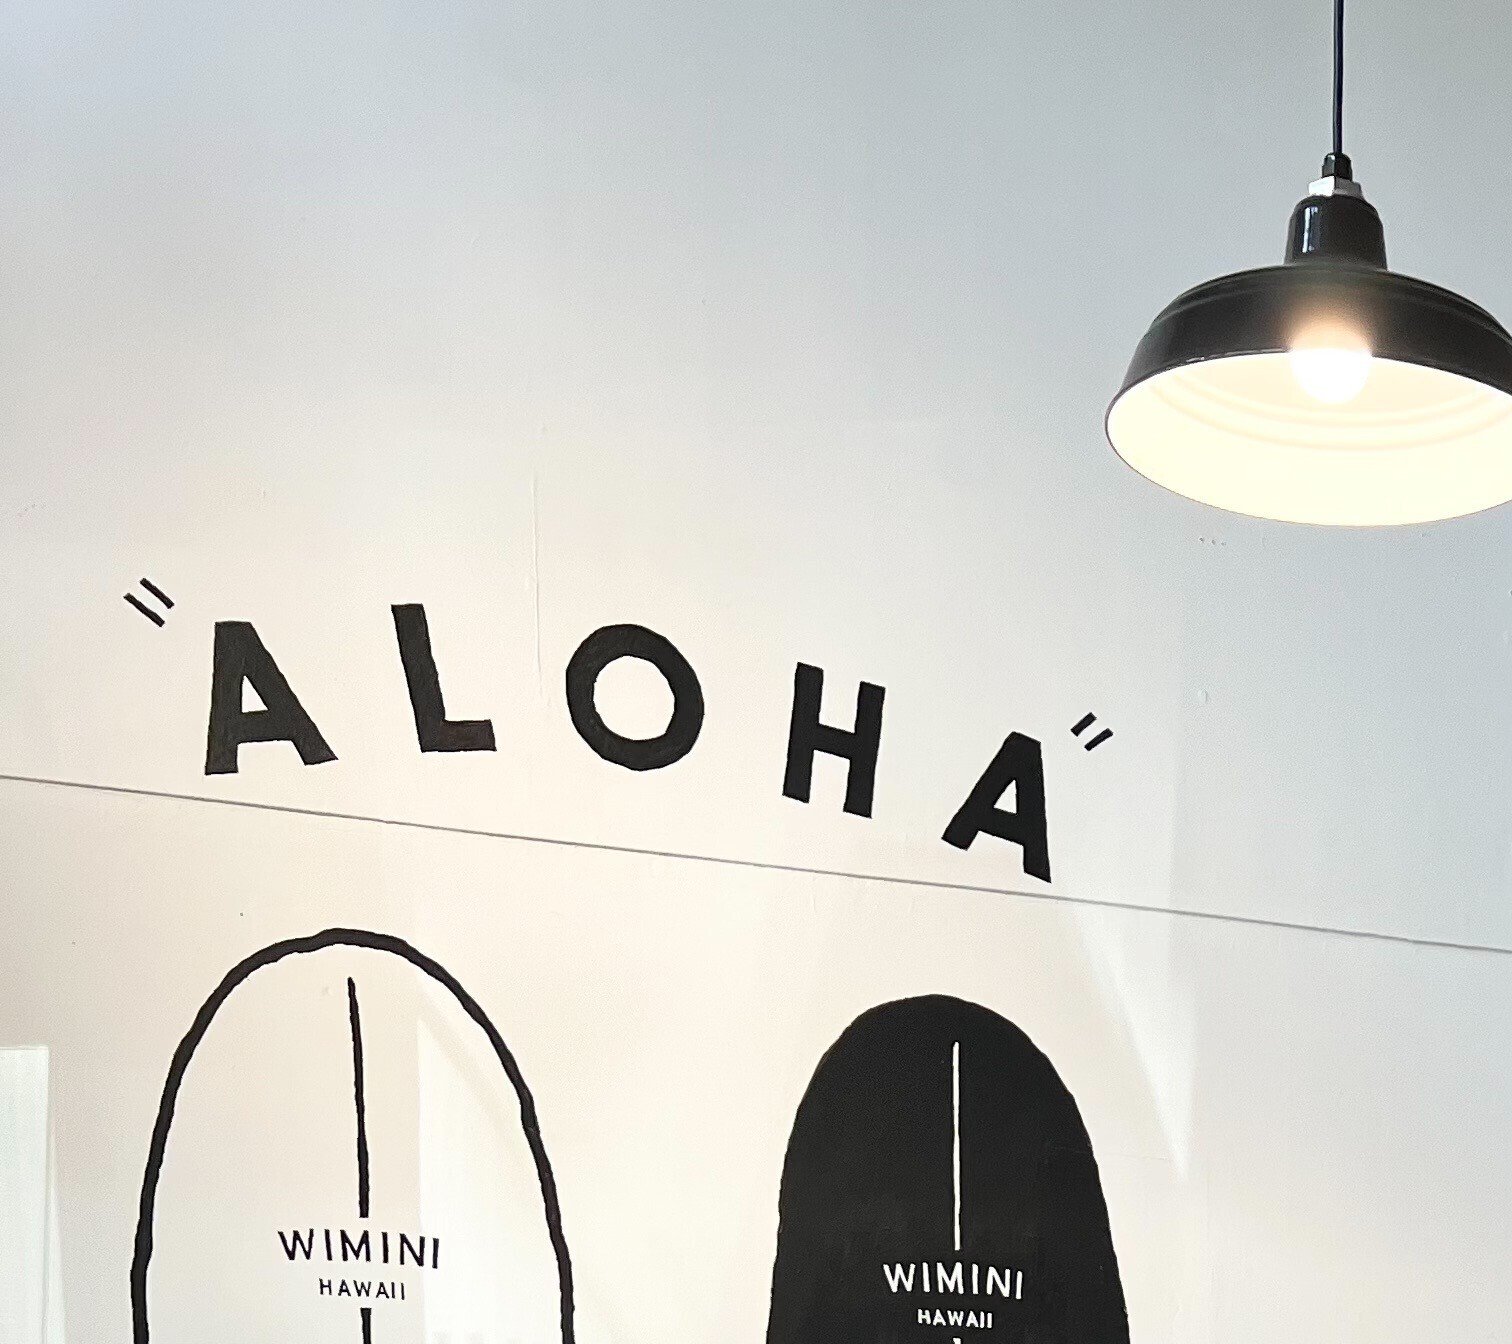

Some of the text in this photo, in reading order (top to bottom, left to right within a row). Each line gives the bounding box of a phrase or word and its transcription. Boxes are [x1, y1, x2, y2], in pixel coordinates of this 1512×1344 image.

[278, 1228, 442, 1269] WIMINI
[319, 1278, 407, 1301] HAWAII
[882, 1261, 1025, 1300] WIMINI
[916, 1308, 994, 1329] HAWAII
